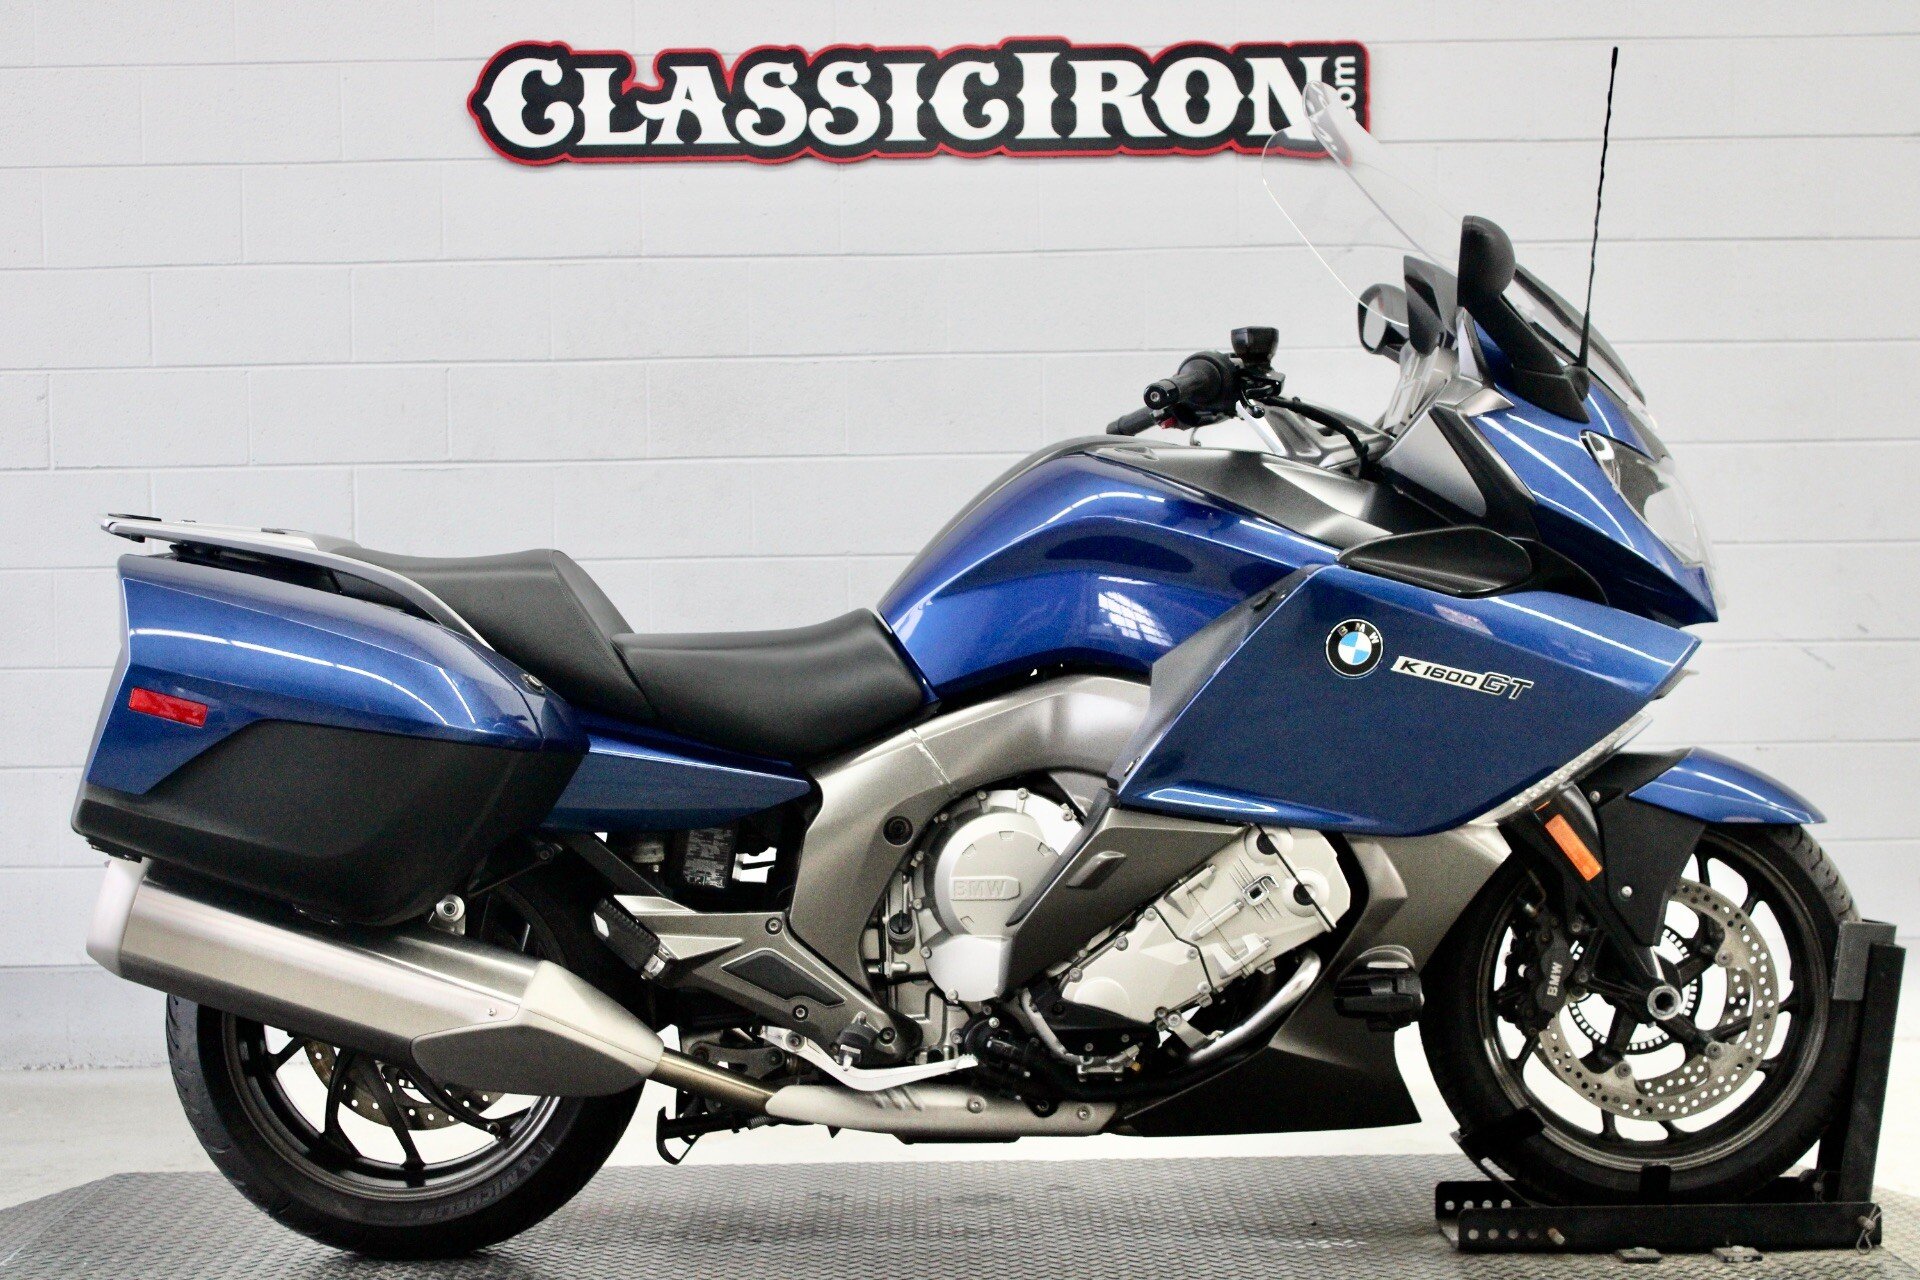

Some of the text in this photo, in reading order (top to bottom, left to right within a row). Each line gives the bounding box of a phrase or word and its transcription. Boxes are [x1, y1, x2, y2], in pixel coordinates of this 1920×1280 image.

[1337, 621, 1380, 645] BMW
[953, 880, 1006, 900] BMW
[1546, 961, 1563, 997] BMW
[419, 1170, 519, 1220] MICHELIN
